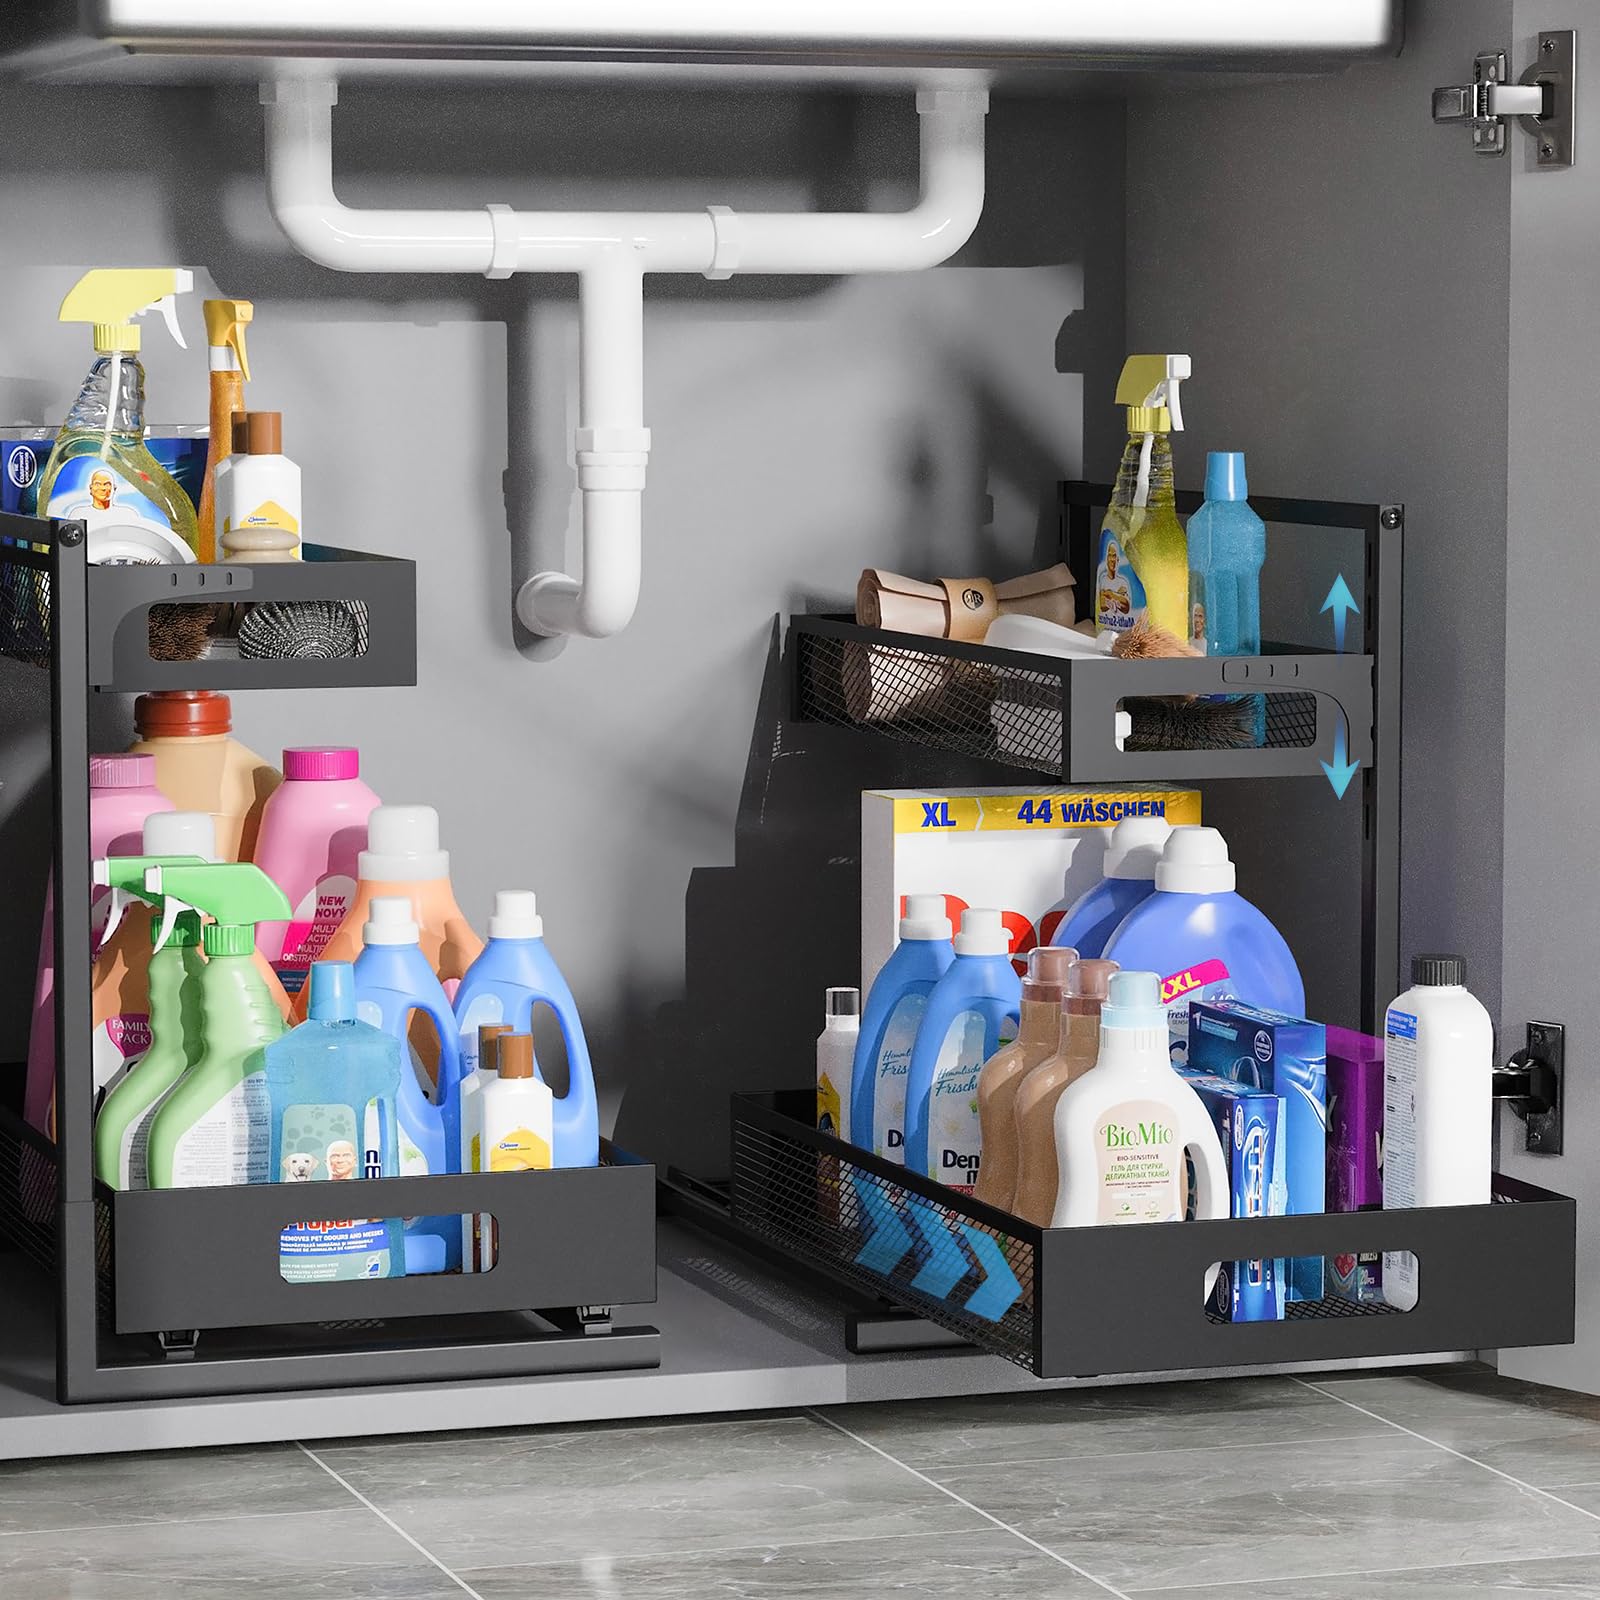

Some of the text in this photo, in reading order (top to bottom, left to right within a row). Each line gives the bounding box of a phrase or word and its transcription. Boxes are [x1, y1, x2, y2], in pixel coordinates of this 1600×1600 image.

[921, 802, 957, 827] XL
[1017, 798, 1166, 824] 44 WÄSCHEN
[318, 895, 346, 906] NEW
[315, 907, 347, 918] NOVÝ
[112, 1019, 149, 1032] FAMILY
[116, 1032, 149, 1045] PACK
[880, 1060, 908, 1078] Fris
[1099, 1121, 1174, 1147] BioMio
[942, 1149, 982, 1169] Den
[1116, 1153, 1160, 1162] BIO-SENSITIVE
